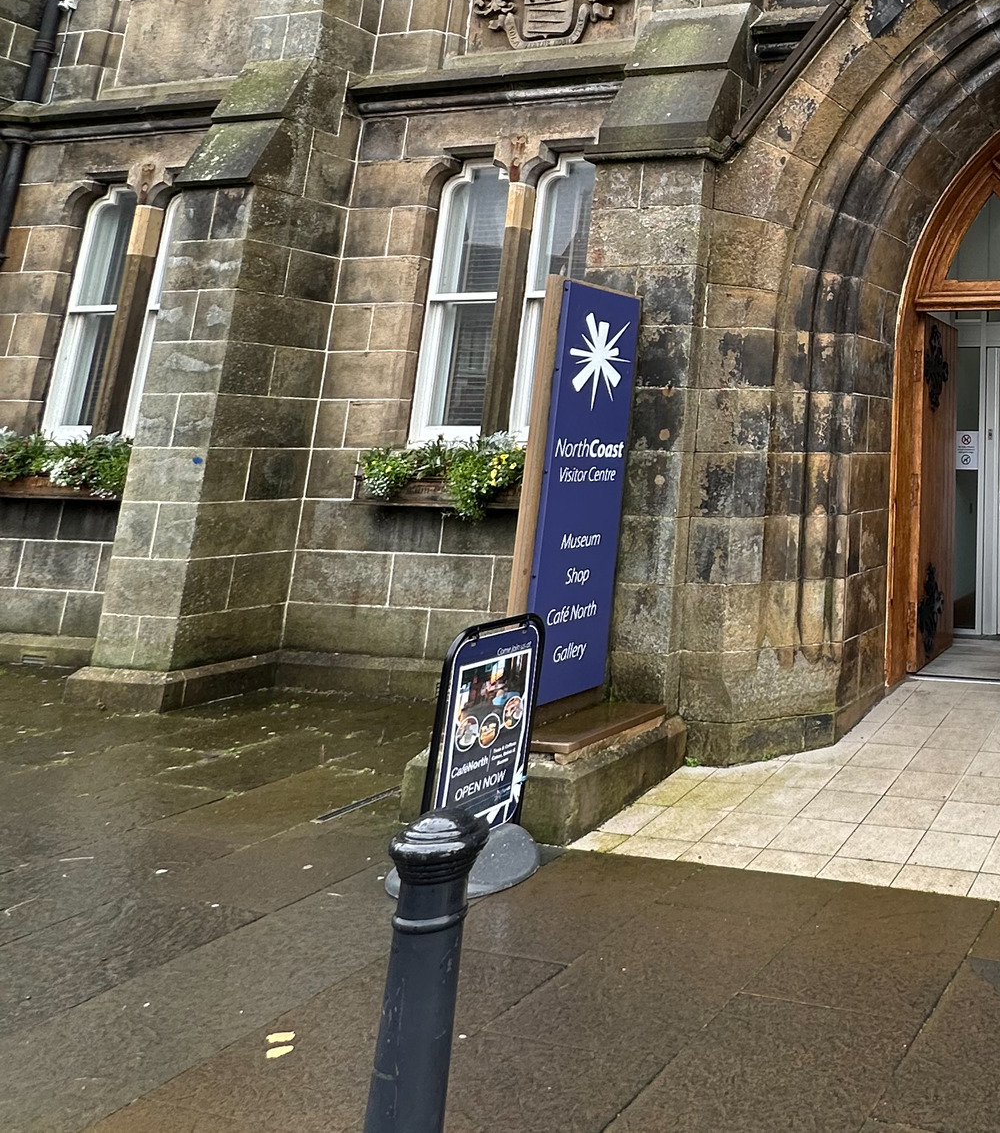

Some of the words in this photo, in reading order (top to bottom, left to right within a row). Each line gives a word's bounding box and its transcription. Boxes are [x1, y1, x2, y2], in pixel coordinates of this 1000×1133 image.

[555, 438, 625, 458] NorthCoast
[559, 467, 588, 483] Visitor
[588, 467, 616, 482] Centre
[560, 533, 601, 550] Museum
[565, 567, 590, 585] Shop
[546, 606, 570, 626] Café
[569, 600, 597, 621] North
[552, 642, 587, 663] Gallery
[454, 780, 482, 802] OPEN
[482, 769, 507, 788] NOW
